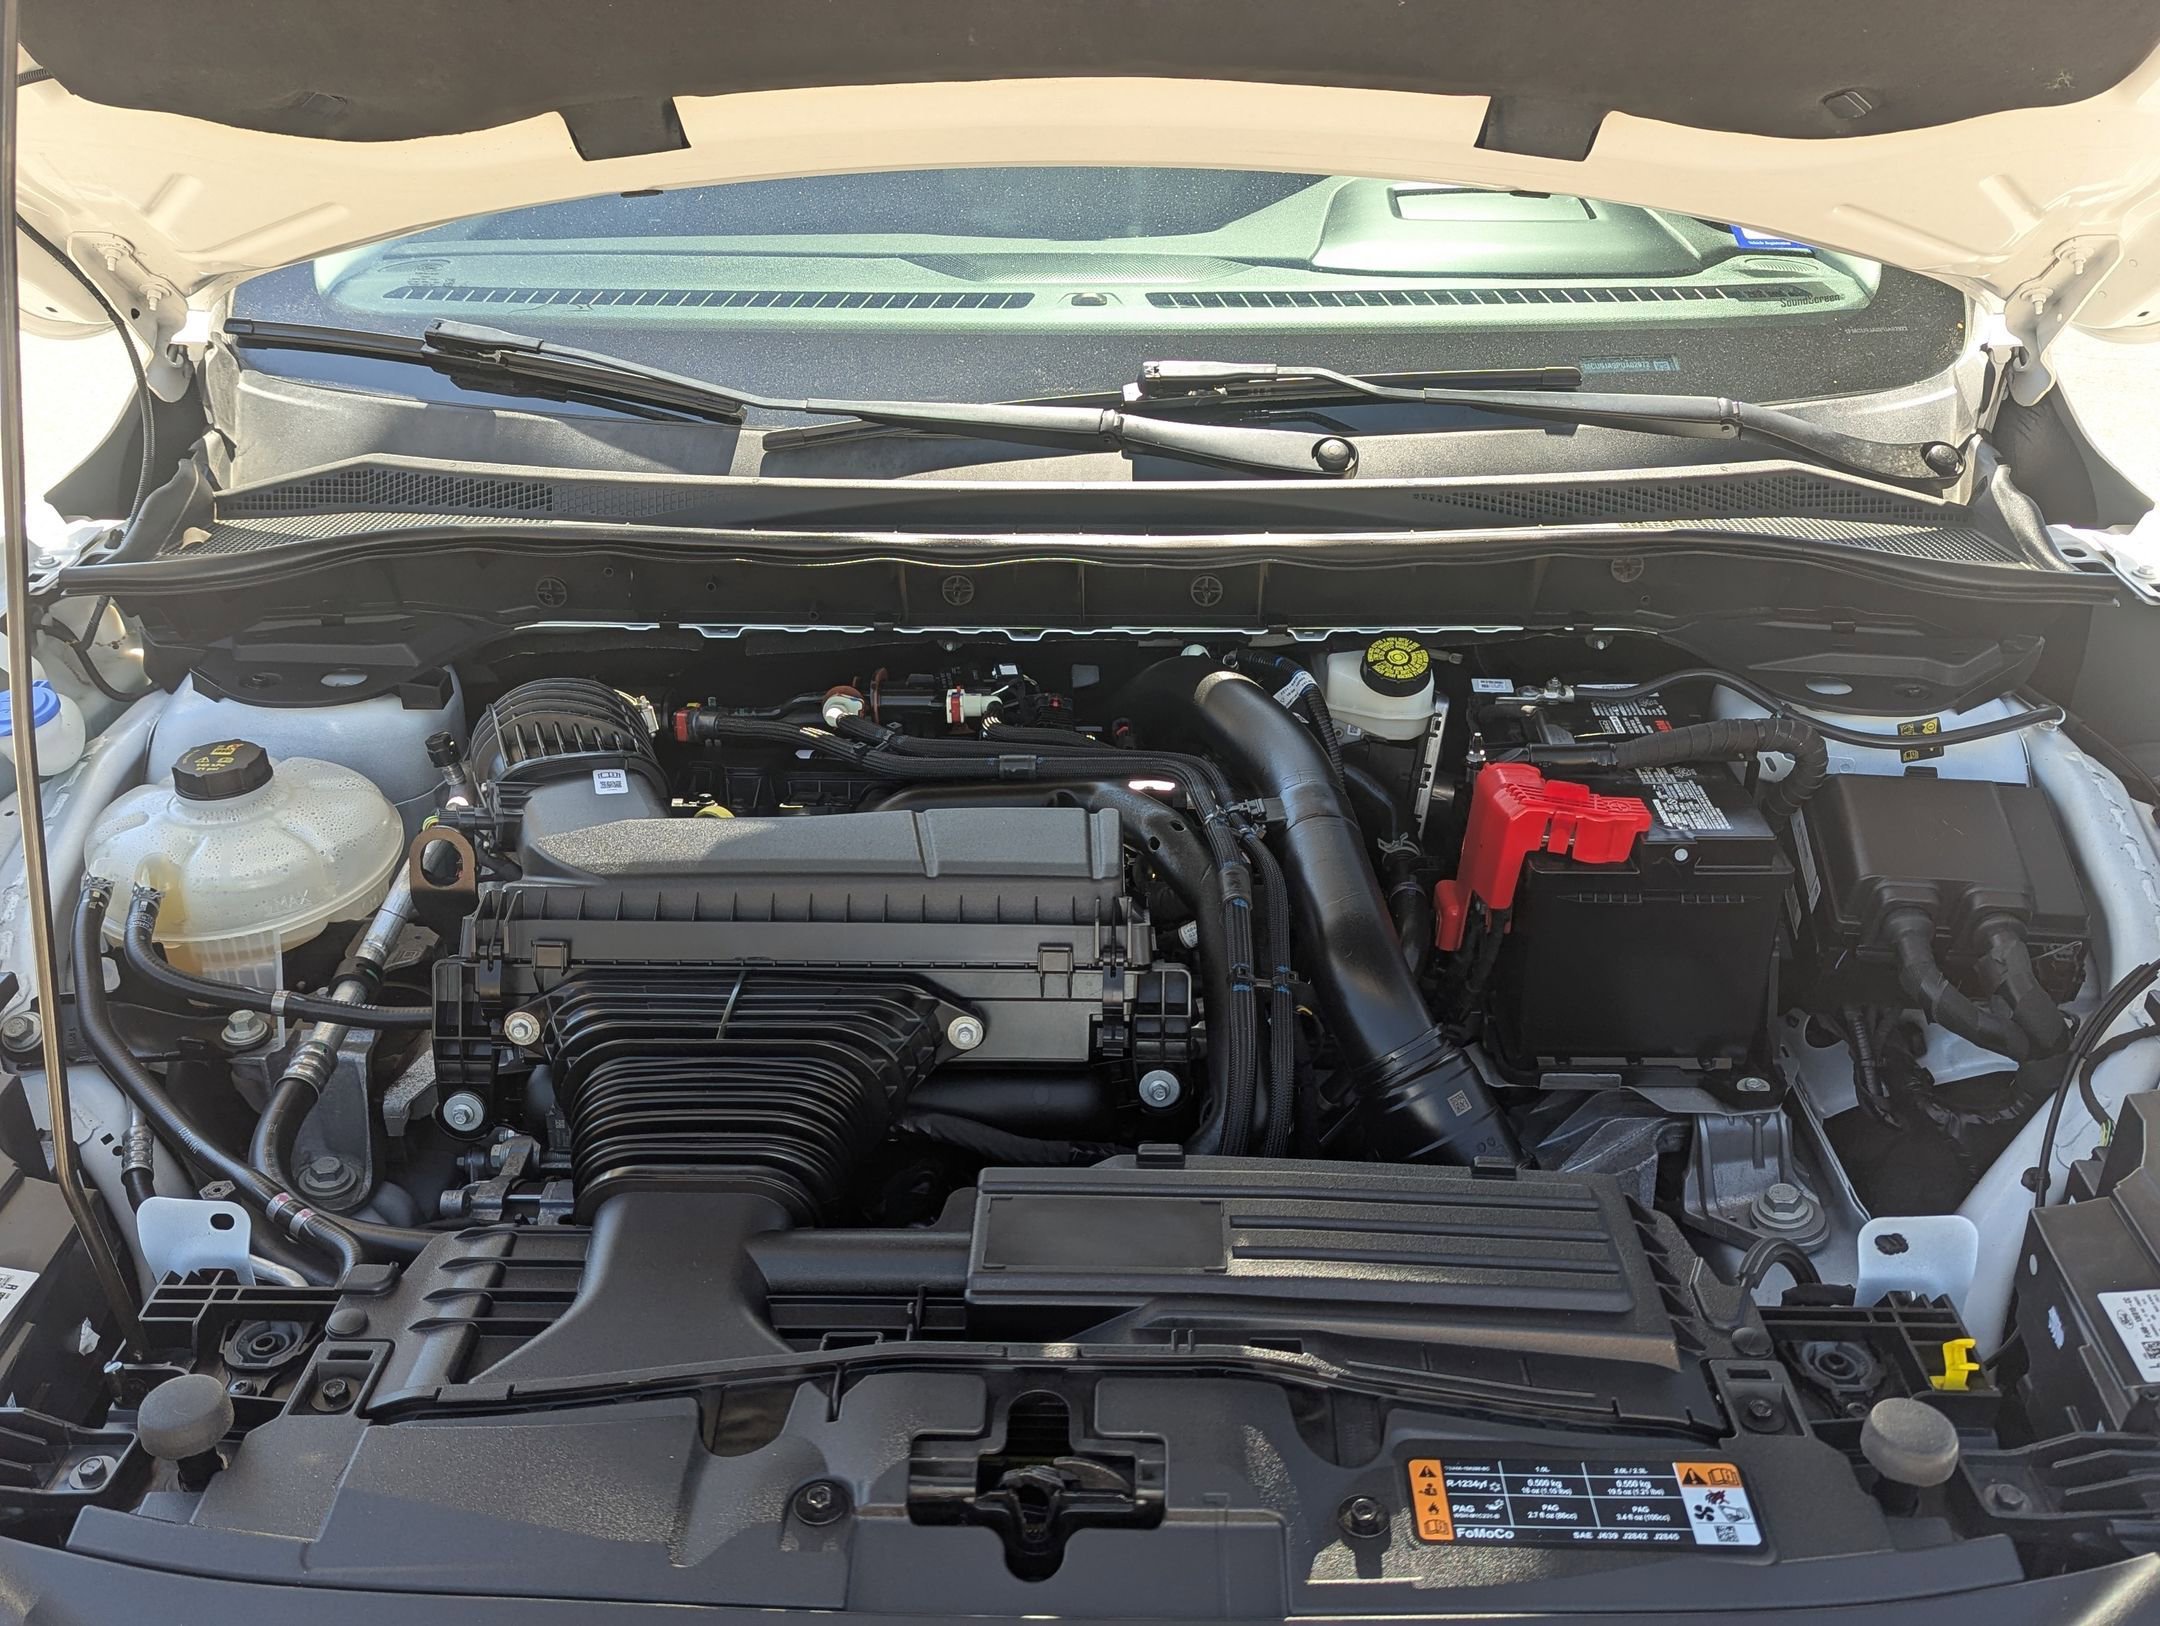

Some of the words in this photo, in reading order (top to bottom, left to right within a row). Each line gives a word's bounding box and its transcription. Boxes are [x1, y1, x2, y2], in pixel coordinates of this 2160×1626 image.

[1446, 1479, 1488, 1490] R-1234yf
[1550, 1479, 1562, 1488] kg
[1639, 1480, 1652, 1489] kg
[1452, 1504, 1475, 1513] PAG
[1541, 1503, 1560, 1511] PAG
[1631, 1505, 1650, 1513] PAG
[1456, 1527, 1515, 1539] FoMoCo
[1572, 1531, 1594, 1539] SAE
